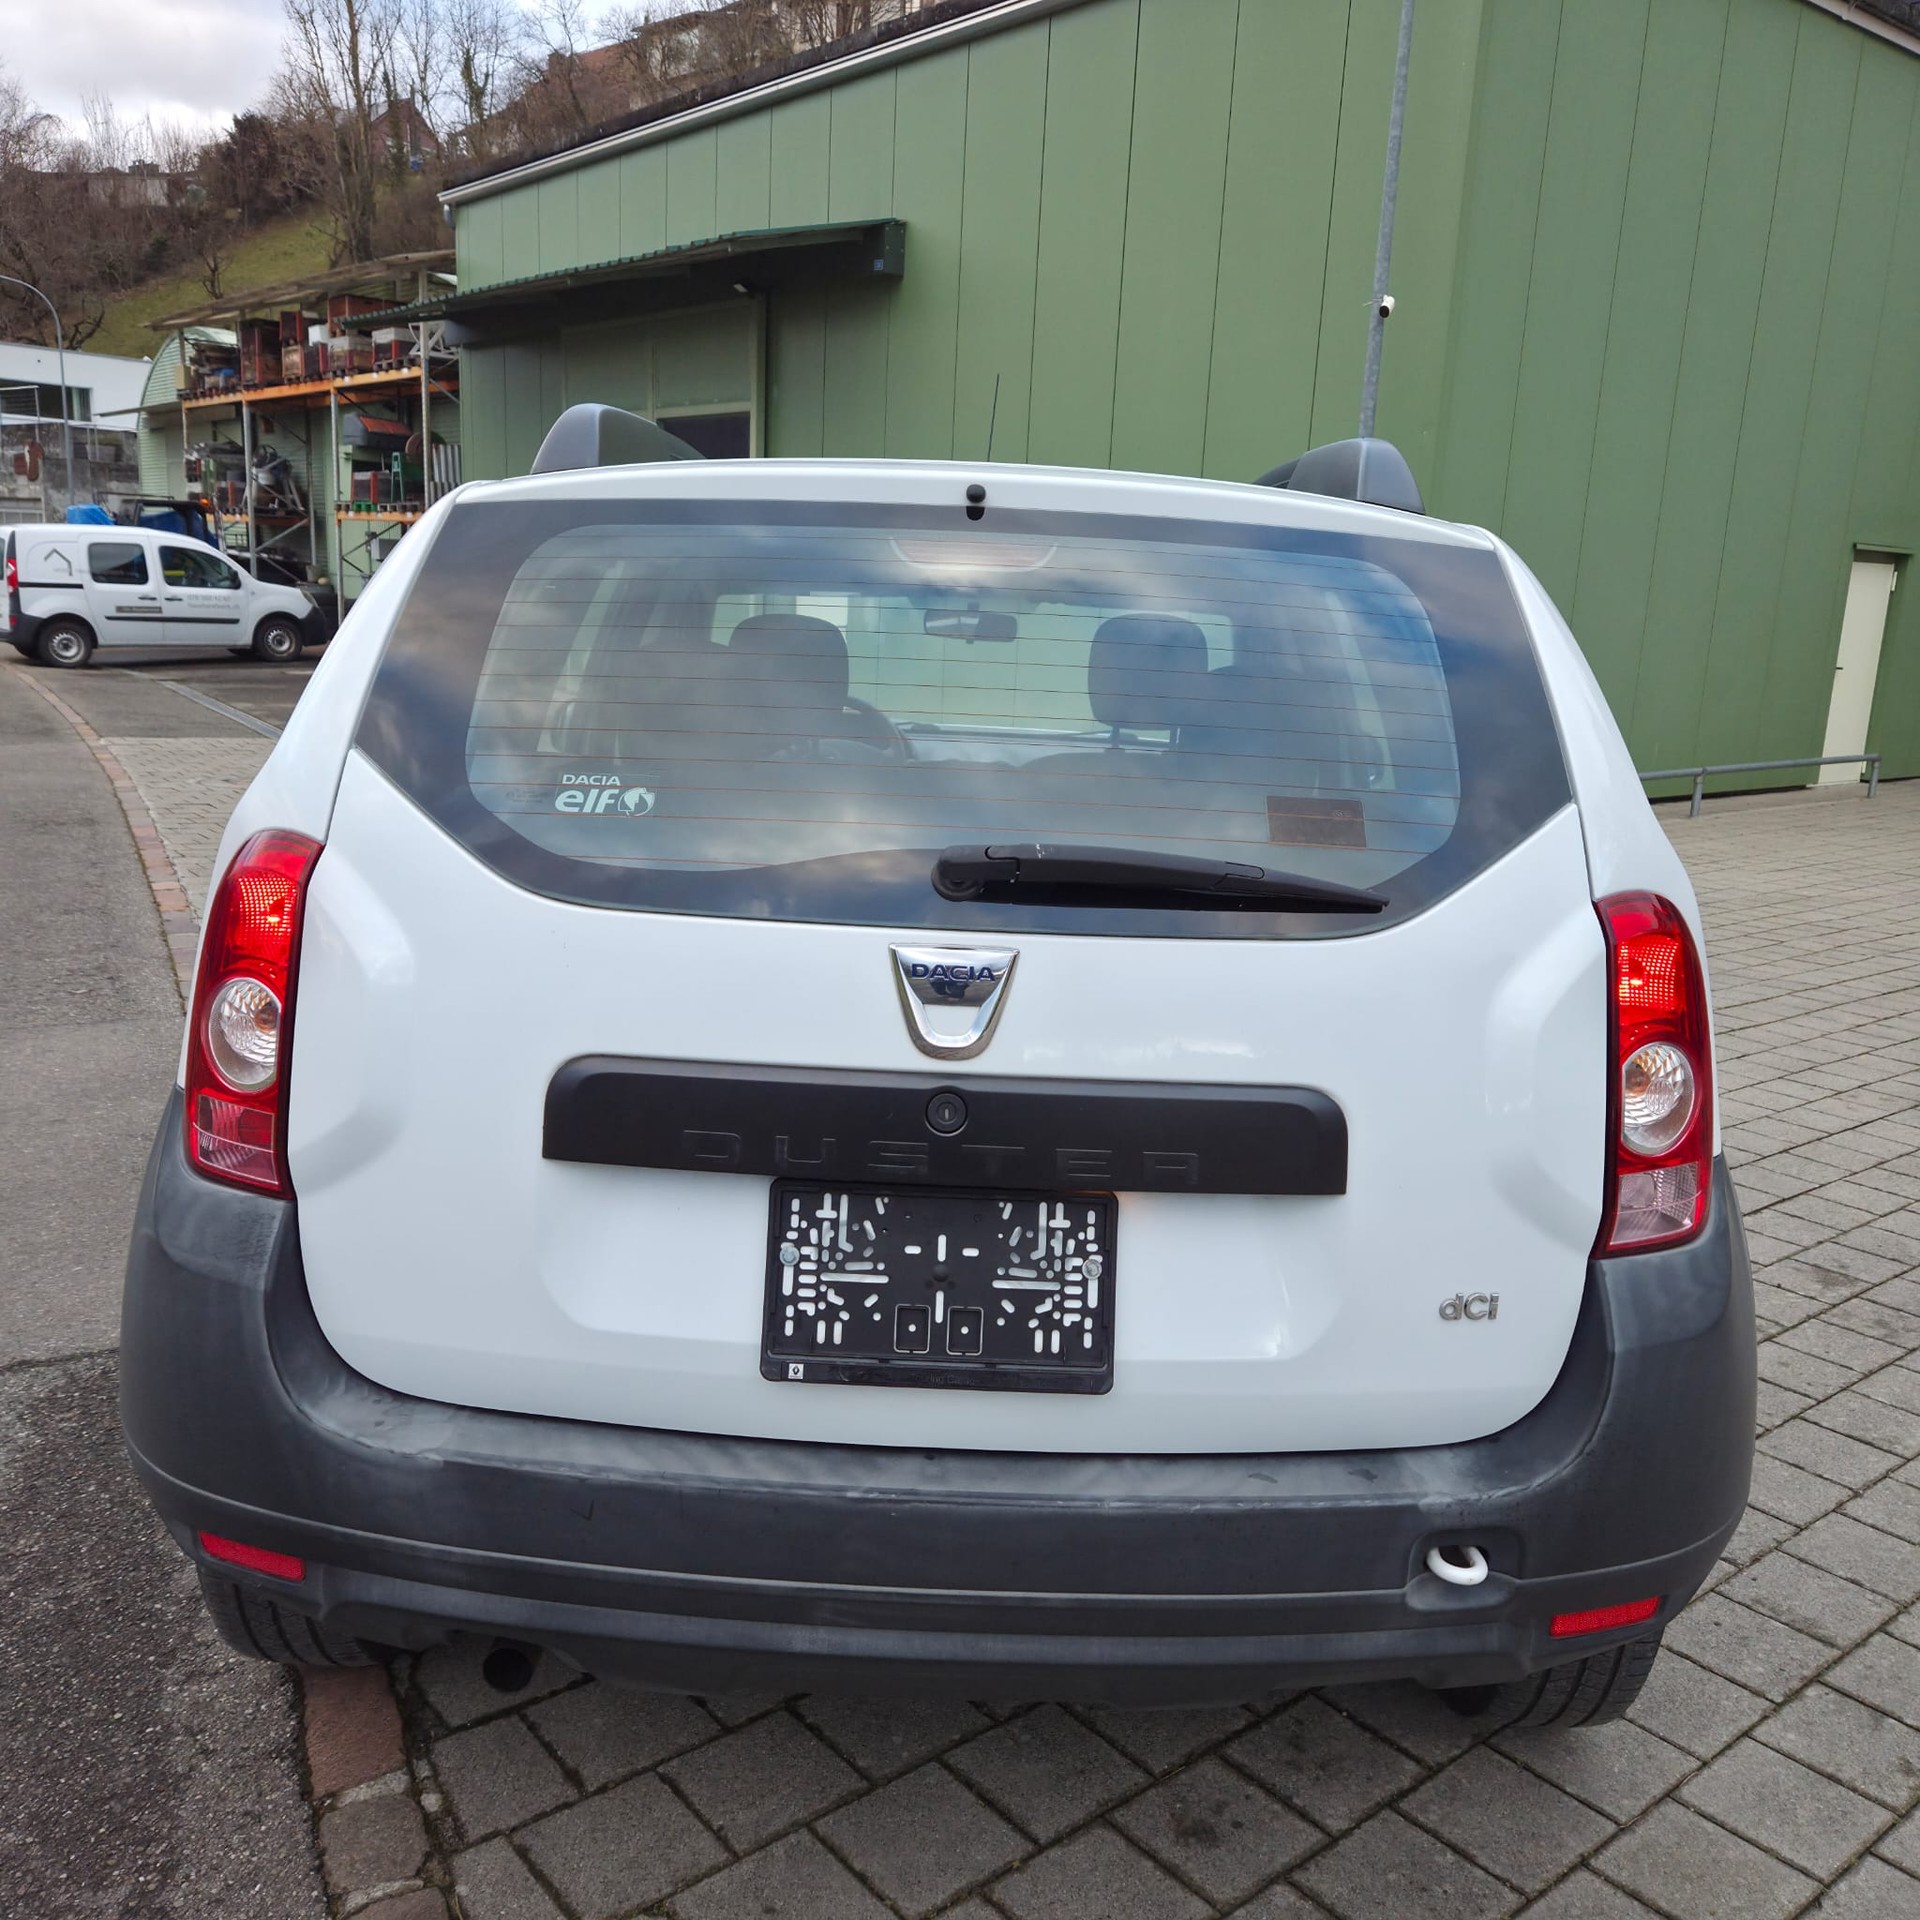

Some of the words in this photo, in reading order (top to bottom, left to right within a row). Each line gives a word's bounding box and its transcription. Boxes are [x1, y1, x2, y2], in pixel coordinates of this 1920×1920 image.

[562, 774, 621, 786] DACIA
[555, 788, 620, 814] elf
[911, 963, 996, 982] DACIA
[682, 1129, 1199, 1186] DUSTER
[1439, 1292, 1500, 1321] dCi
